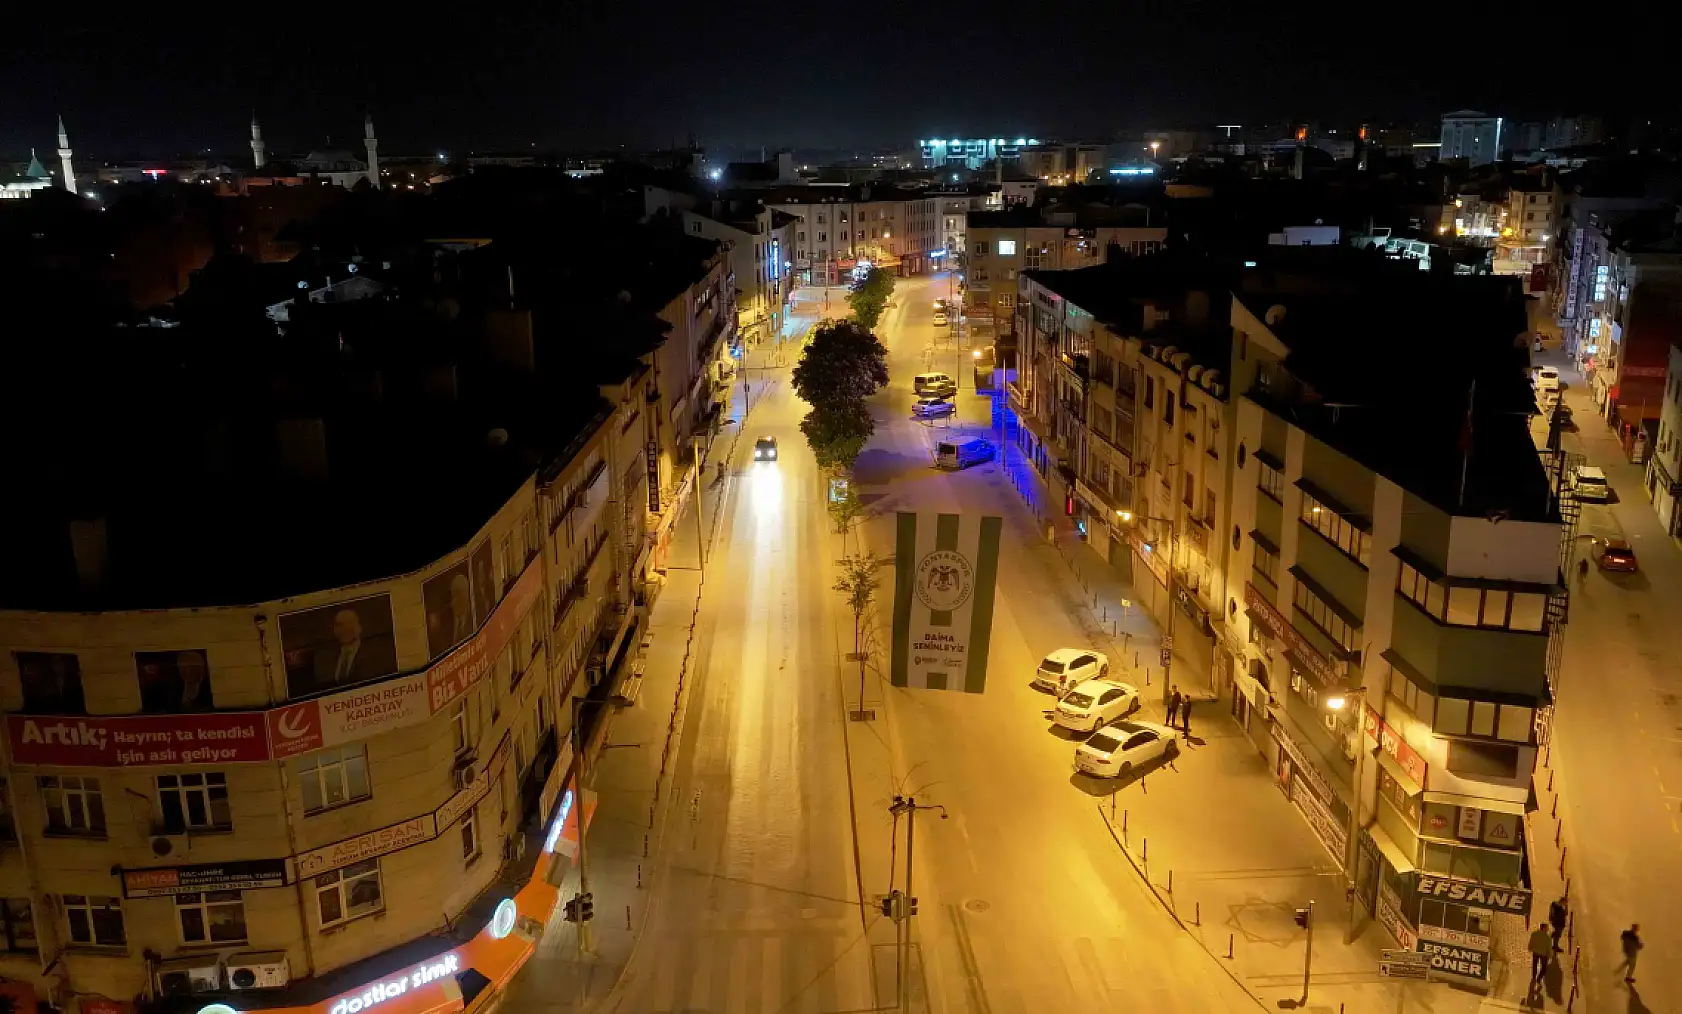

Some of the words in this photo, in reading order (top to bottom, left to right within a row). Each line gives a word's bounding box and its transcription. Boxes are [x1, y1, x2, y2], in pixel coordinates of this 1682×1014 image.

[920, 552, 970, 577] KONYASPOR
[924, 633, 954, 643] DAİMA
[324, 693, 382, 715] YENİDEN
[383, 682, 424, 700] REFAH
[346, 699, 404, 722] KARATAY
[22, 719, 108, 750] Artık;
[199, 725, 255, 741] kendisi
[117, 749, 145, 765] işin
[150, 749, 177, 761] aslı
[182, 747, 238, 763] geliyor
[1417, 878, 1526, 910] EFSANE
[1423, 942, 1482, 963] EFSANE
[1431, 955, 1482, 977] ÖNER
[330, 974, 408, 1014] dostlar
[413, 953, 459, 988] simit
